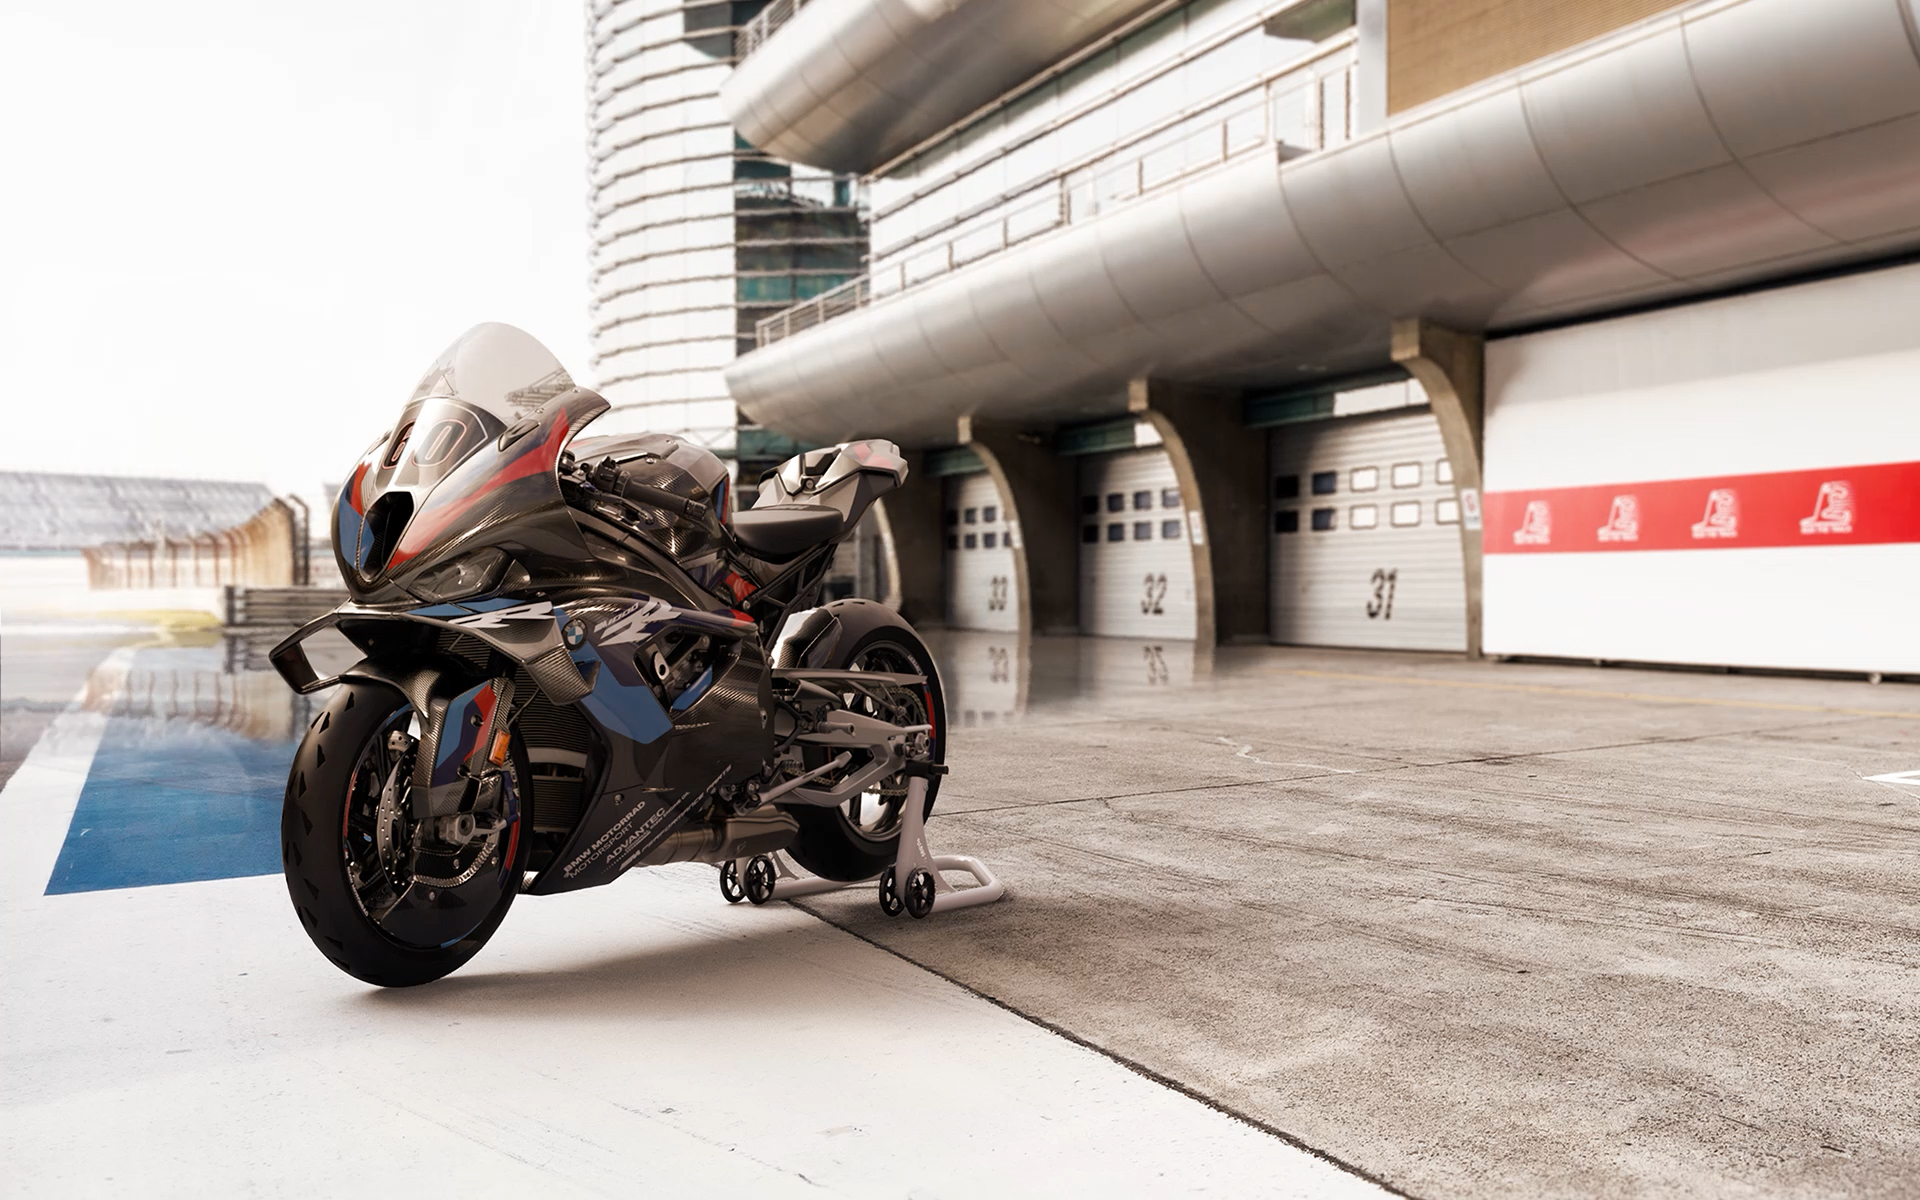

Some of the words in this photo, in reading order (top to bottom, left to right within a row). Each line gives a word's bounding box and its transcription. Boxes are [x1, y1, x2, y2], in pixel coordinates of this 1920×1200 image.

[988, 576, 1008, 612] 33
[1141, 573, 1168, 615] 32
[1366, 568, 1399, 620] 31
[563, 848, 592, 872] BMW
[591, 801, 646, 850] MOTORRAD
[569, 821, 633, 878] MOTORSPORT
[606, 807, 666, 864] ADVANTEC
